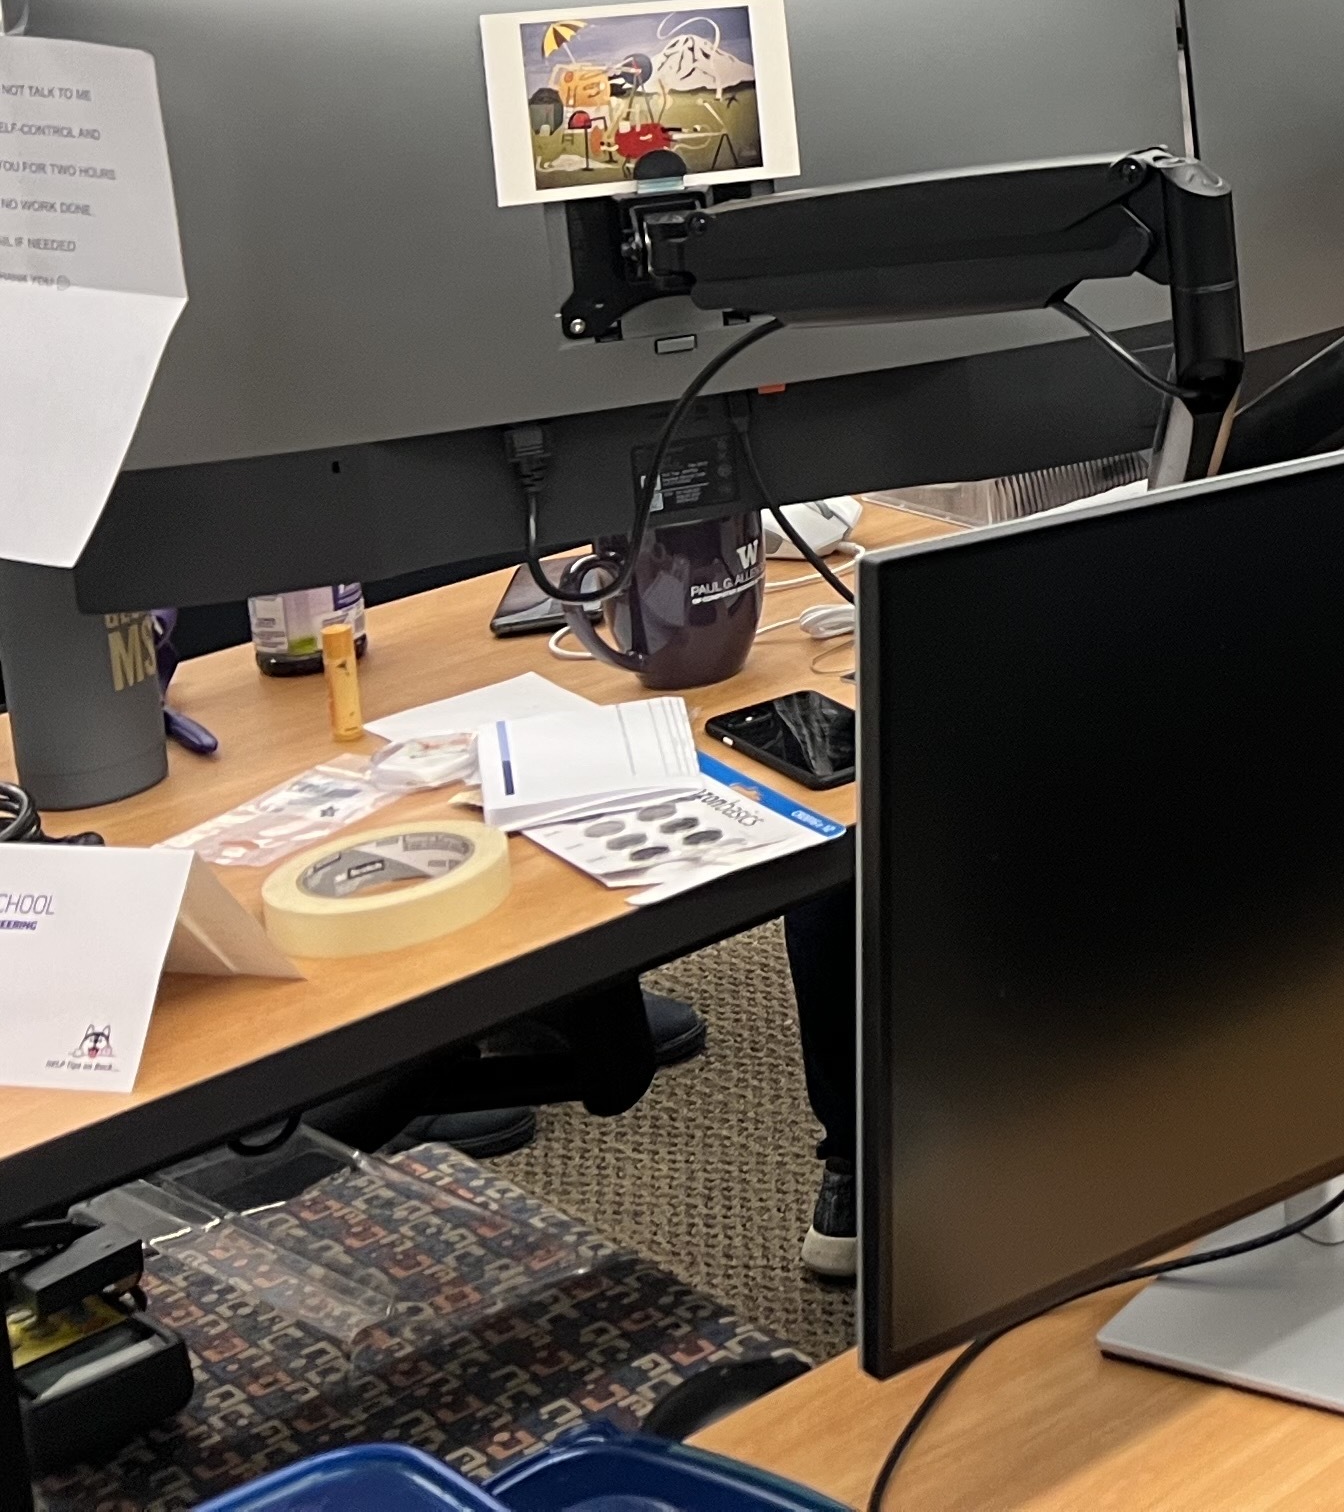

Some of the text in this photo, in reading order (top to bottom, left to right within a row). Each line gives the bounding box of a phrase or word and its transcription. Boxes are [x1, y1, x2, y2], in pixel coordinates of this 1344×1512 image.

[2, 84, 92, 102] NOT TALK TO ME
[78, 128, 101, 141] AND
[22, 161, 47, 175] FOR
[50, 163, 76, 177] TWO
[78, 166, 117, 181] HOURS
[21, 200, 57, 213] WORK
[27, 238, 76, 253] NEEDED
[735, 539, 759, 570] W
[690, 581, 722, 598] PAUL
